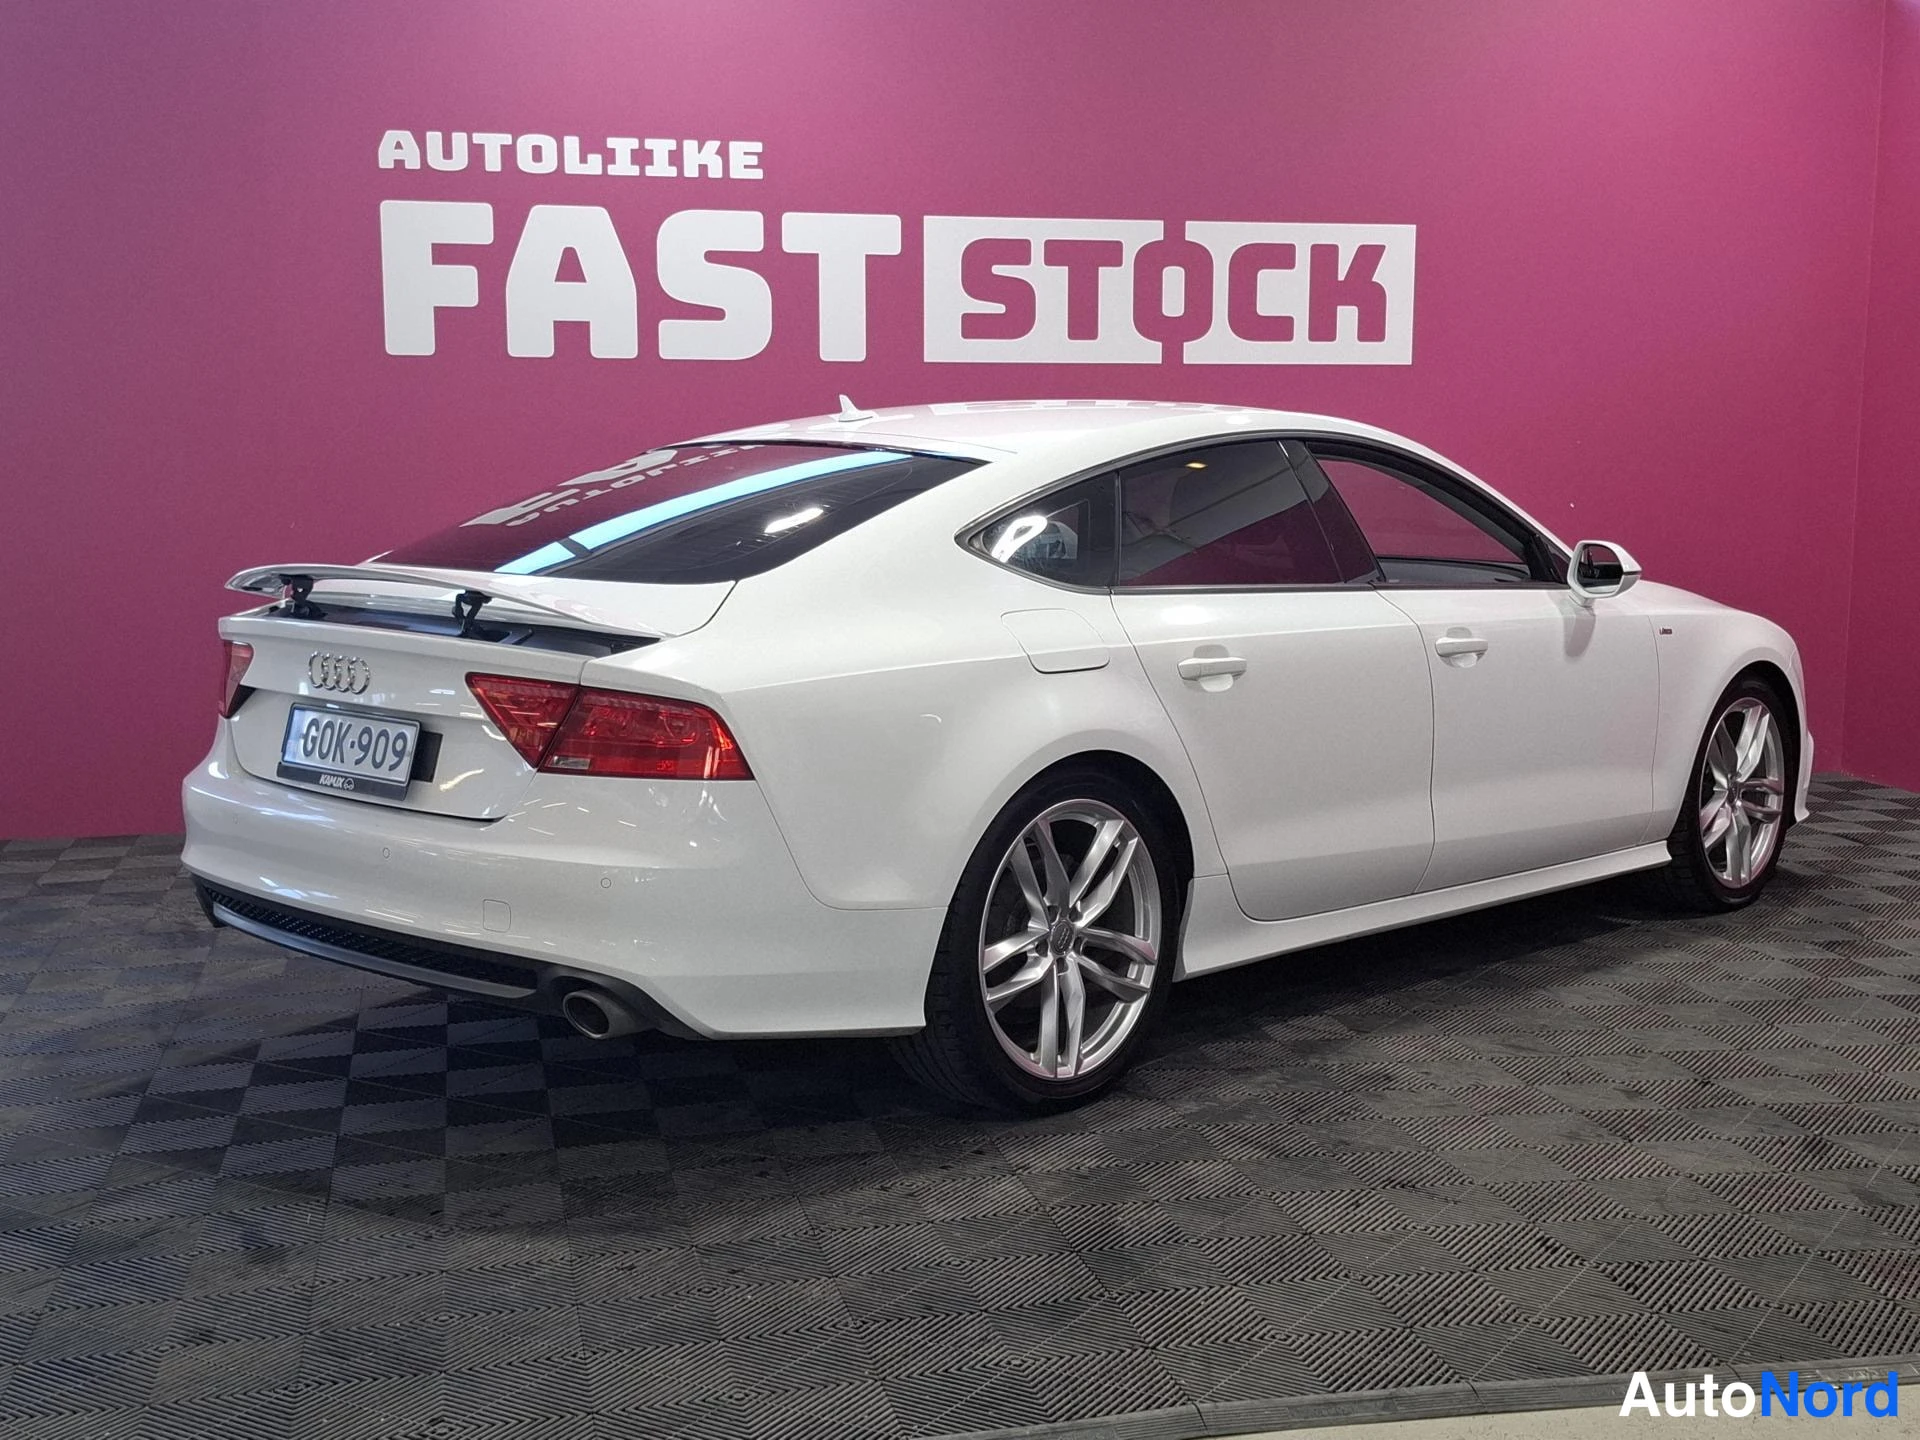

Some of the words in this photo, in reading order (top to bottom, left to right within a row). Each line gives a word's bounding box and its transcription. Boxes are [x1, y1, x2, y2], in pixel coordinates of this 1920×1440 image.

[378, 130, 764, 180] AUTOLIIKE
[380, 200, 902, 362] FAST
[960, 237, 1389, 343] STOCK
[302, 717, 409, 772] GOK-909
